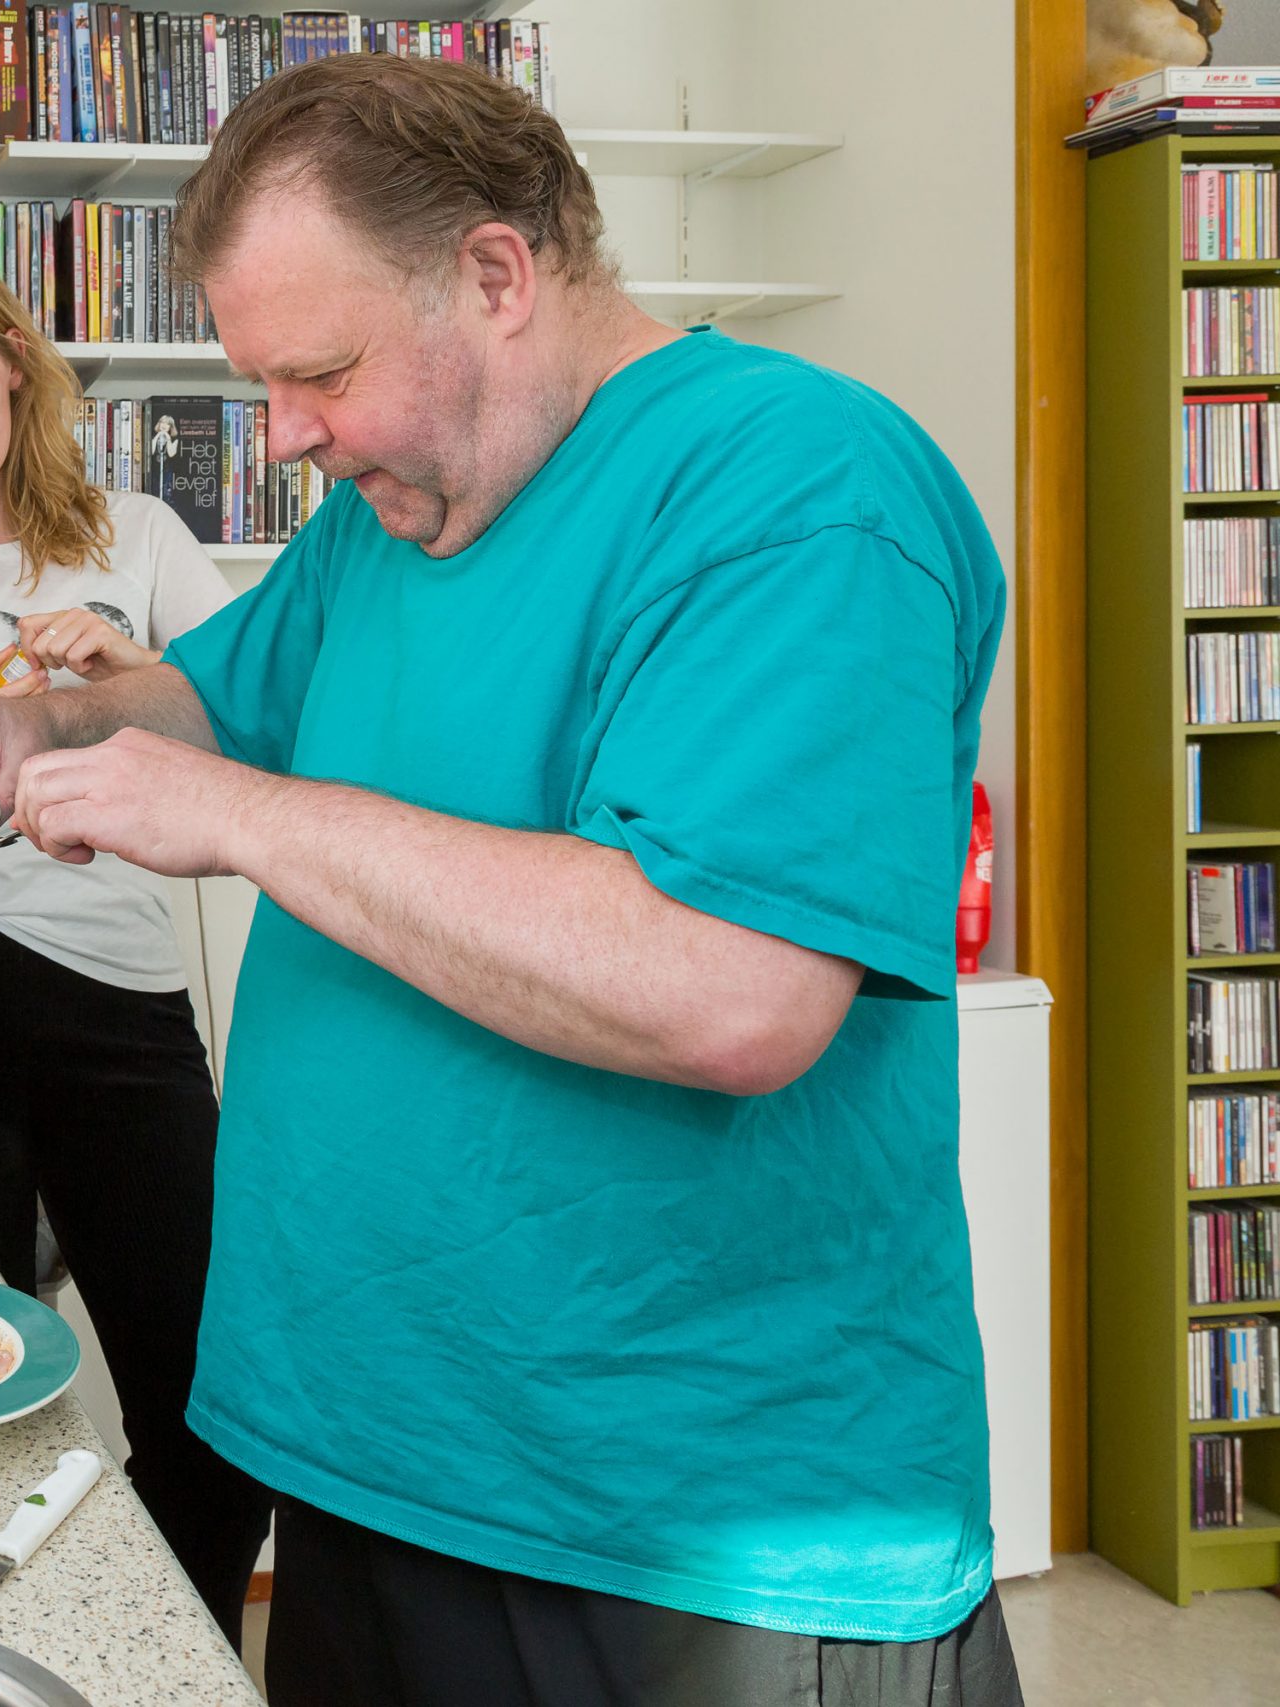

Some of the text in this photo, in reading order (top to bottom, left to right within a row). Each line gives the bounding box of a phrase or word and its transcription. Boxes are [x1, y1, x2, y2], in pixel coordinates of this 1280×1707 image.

[4, 41, 13, 63] Doors
[251, 33, 260, 79] ANTHOLOGY
[124, 241, 133, 308] BLONDIE LIVE
[180, 440, 217, 458] Heb
[189, 457, 217, 475] het
[172, 472, 217, 490] leven
[195, 490, 217, 507] lief
